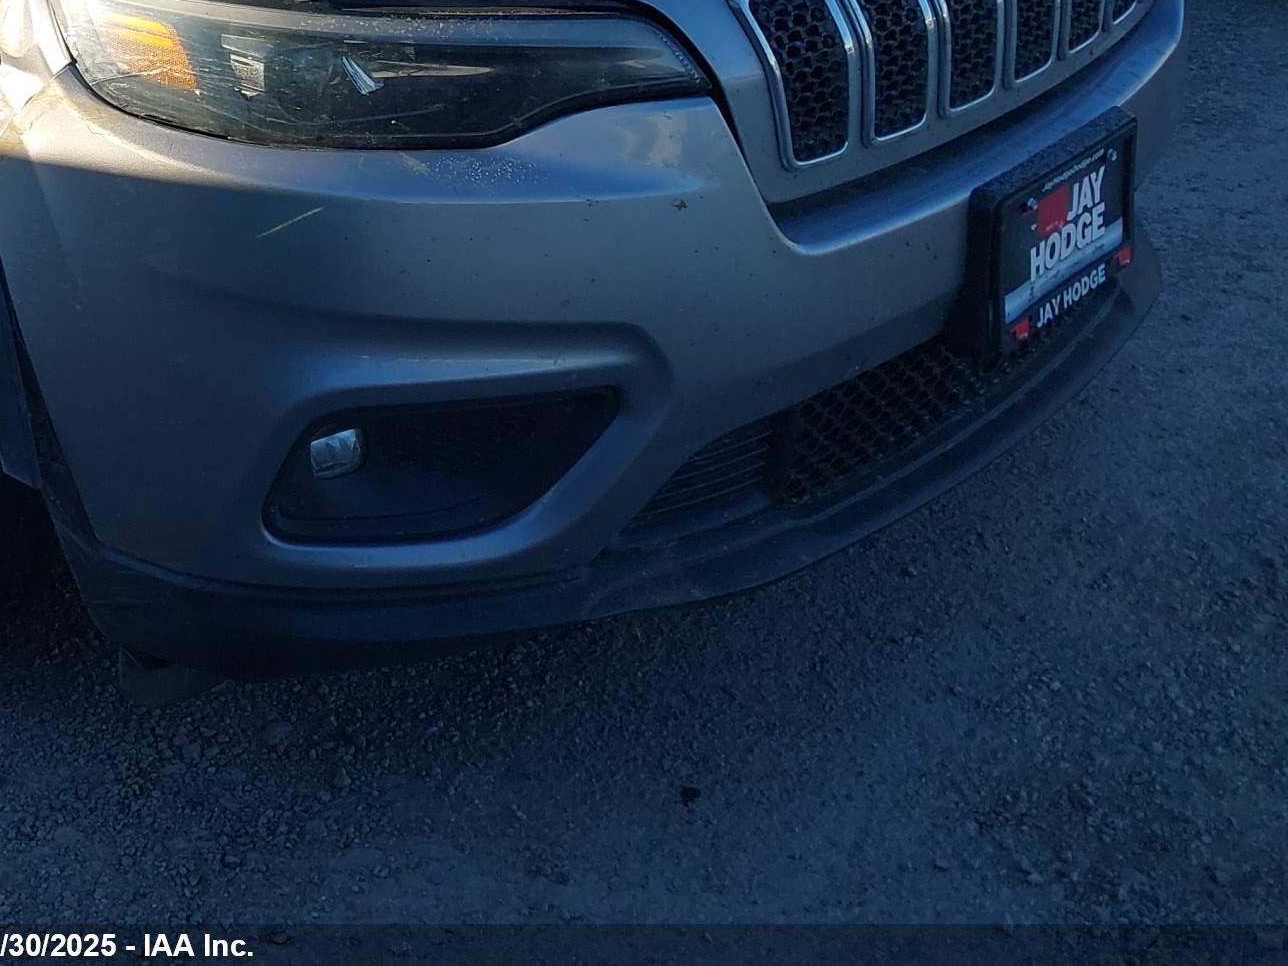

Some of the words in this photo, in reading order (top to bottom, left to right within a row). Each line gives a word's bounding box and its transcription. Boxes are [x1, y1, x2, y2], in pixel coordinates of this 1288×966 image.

[1067, 166, 1106, 221] JAY
[1030, 202, 1106, 282] HODGE
[1037, 294, 1061, 328] JAY
[1063, 264, 1107, 309] HODGE
